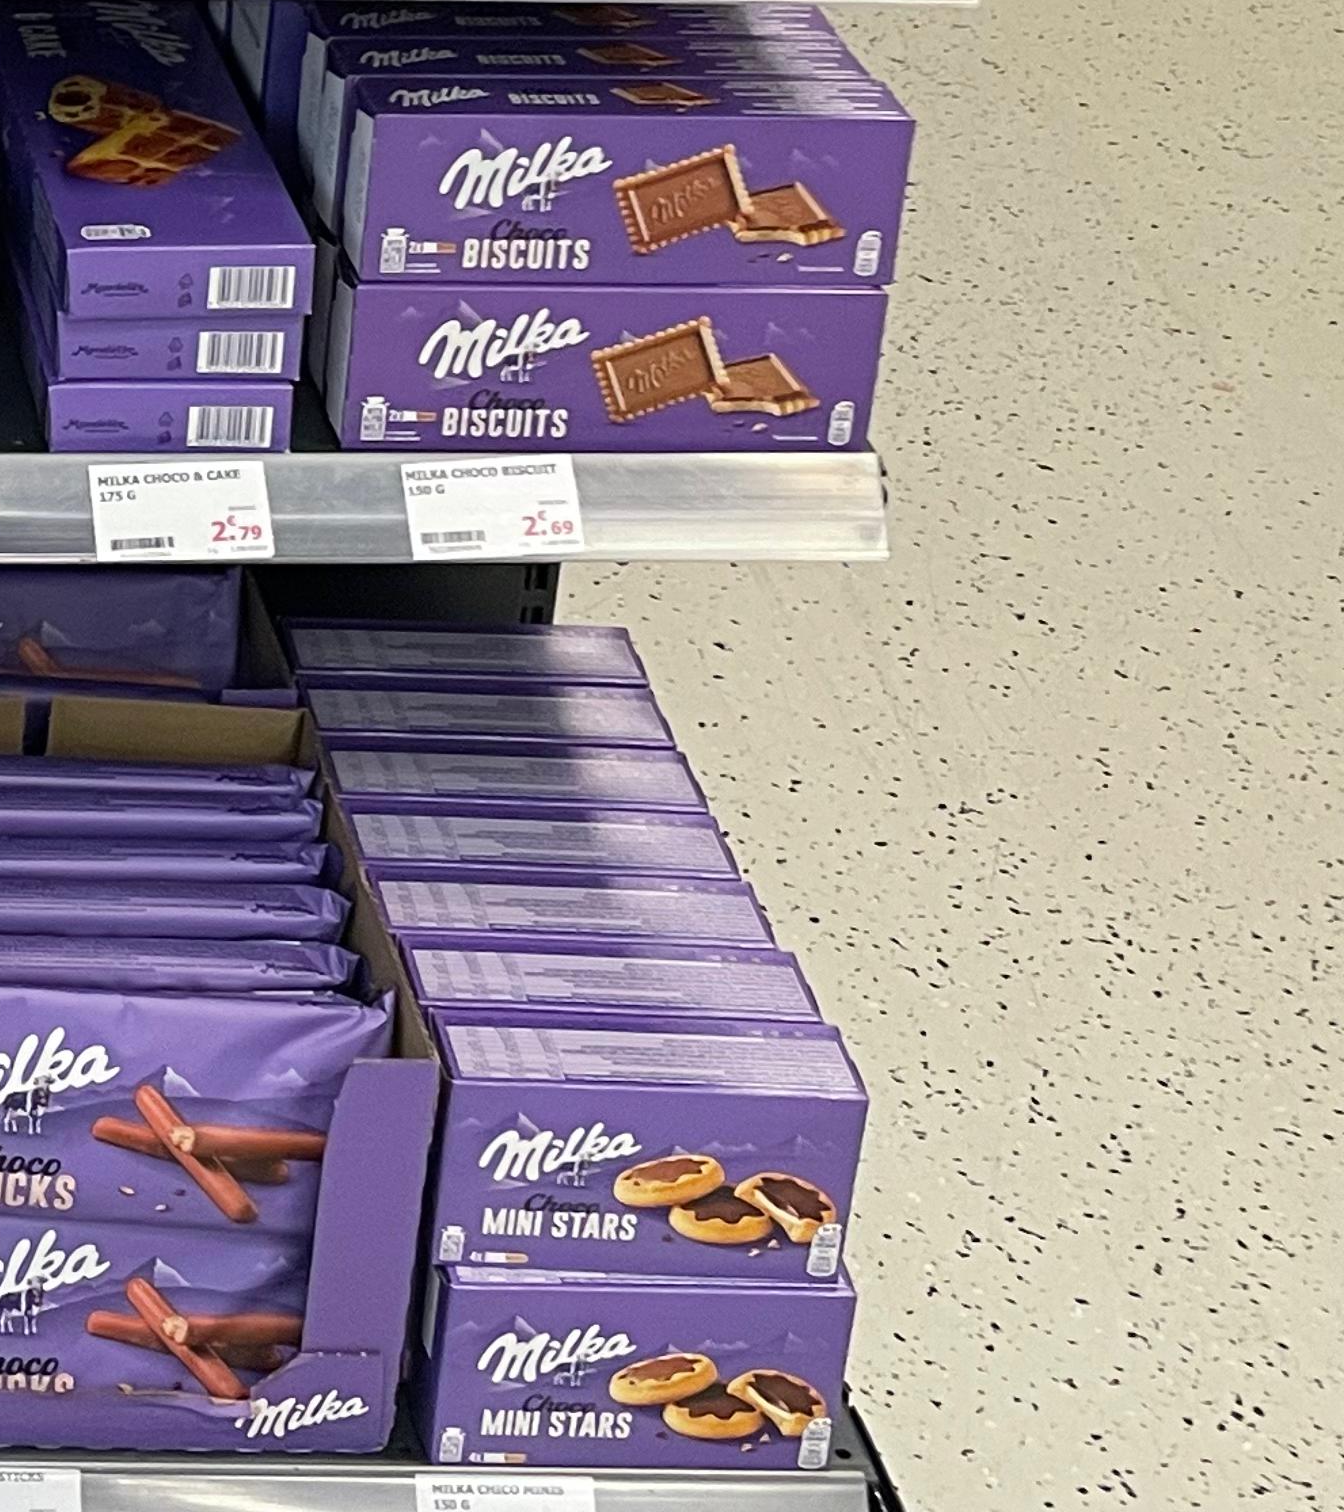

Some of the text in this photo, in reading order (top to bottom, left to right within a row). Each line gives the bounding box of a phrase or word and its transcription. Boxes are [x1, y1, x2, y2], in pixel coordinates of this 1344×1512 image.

[439, 136, 613, 210] Milka
[462, 238, 591, 270] BISCUITS
[418, 307, 591, 380] Milka
[442, 407, 569, 439] BISCUITS
[97, 475, 140, 487] MILKA
[143, 472, 189, 485] CHOCO
[207, 469, 240, 481] CAKE
[477, 1122, 642, 1184] Milka
[481, 1207, 638, 1242] MINI STARS
[476, 1325, 637, 1385] Milka
[480, 1409, 633, 1439] MINI STARS
